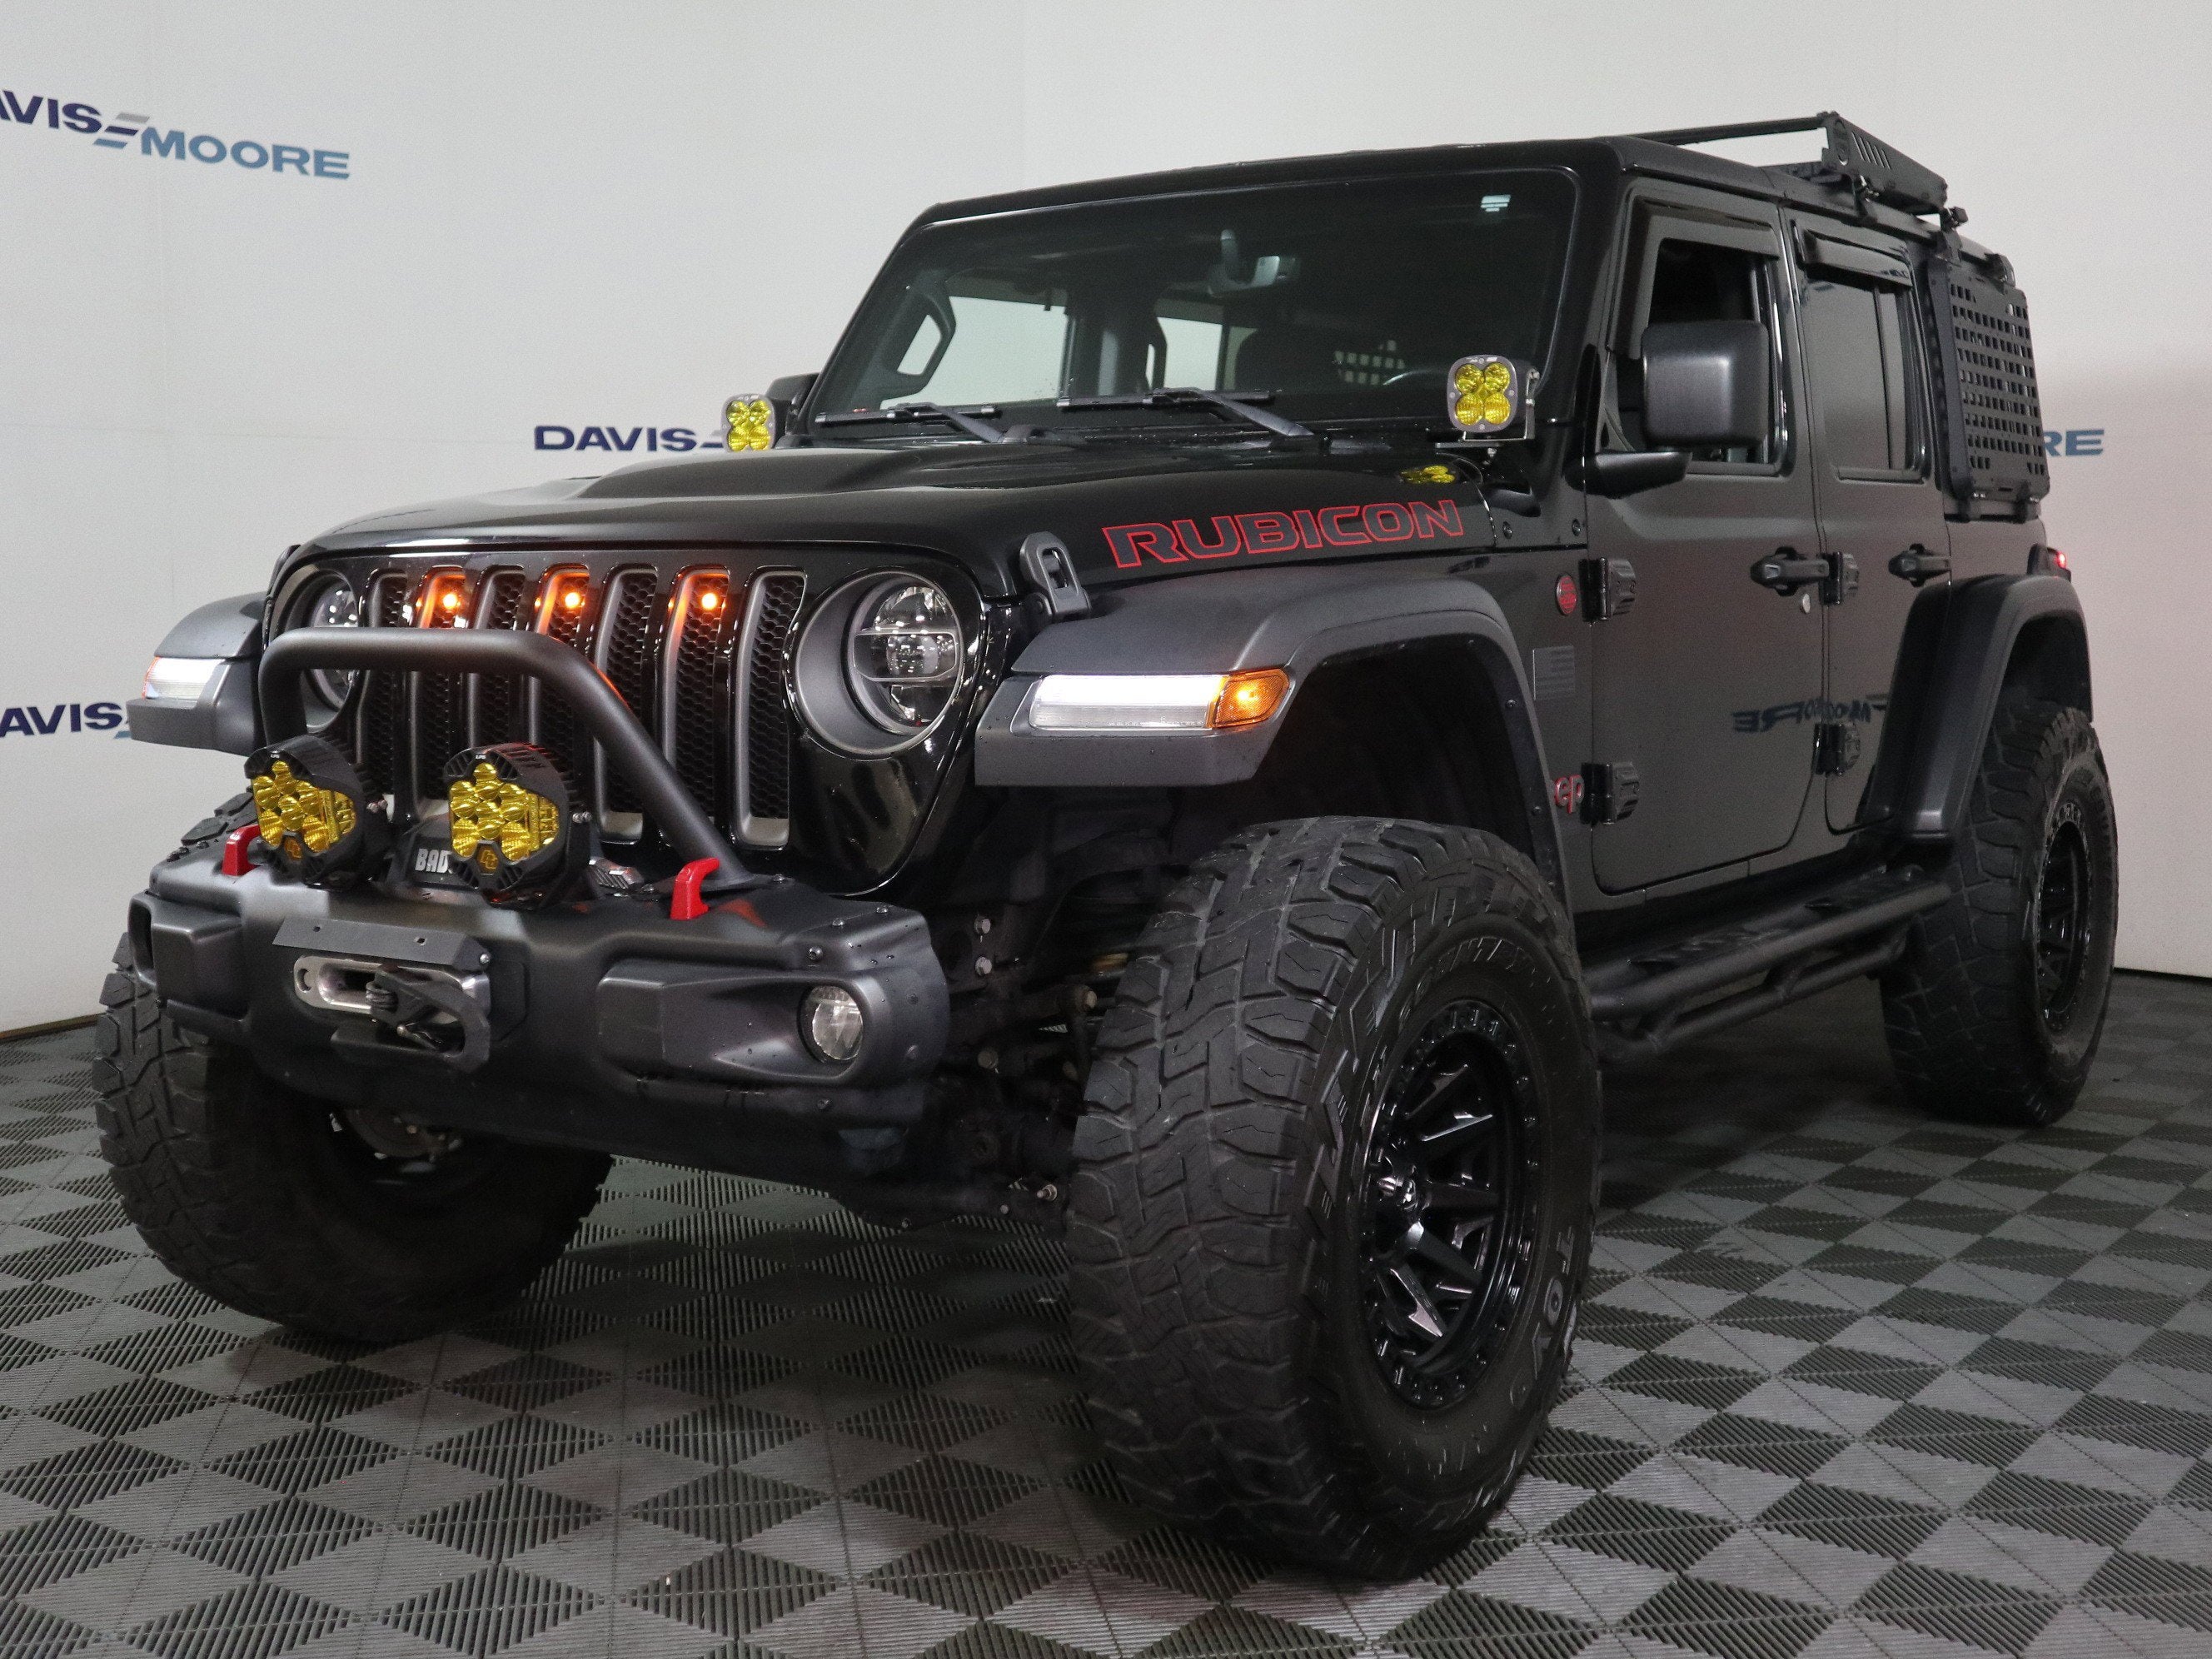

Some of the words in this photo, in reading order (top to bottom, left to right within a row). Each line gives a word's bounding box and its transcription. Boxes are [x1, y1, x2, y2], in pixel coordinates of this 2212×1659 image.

[140, 126, 350, 180] MOORE
[533, 425, 698, 451] DAVIS
[1102, 499, 1464, 569] RUBICON
